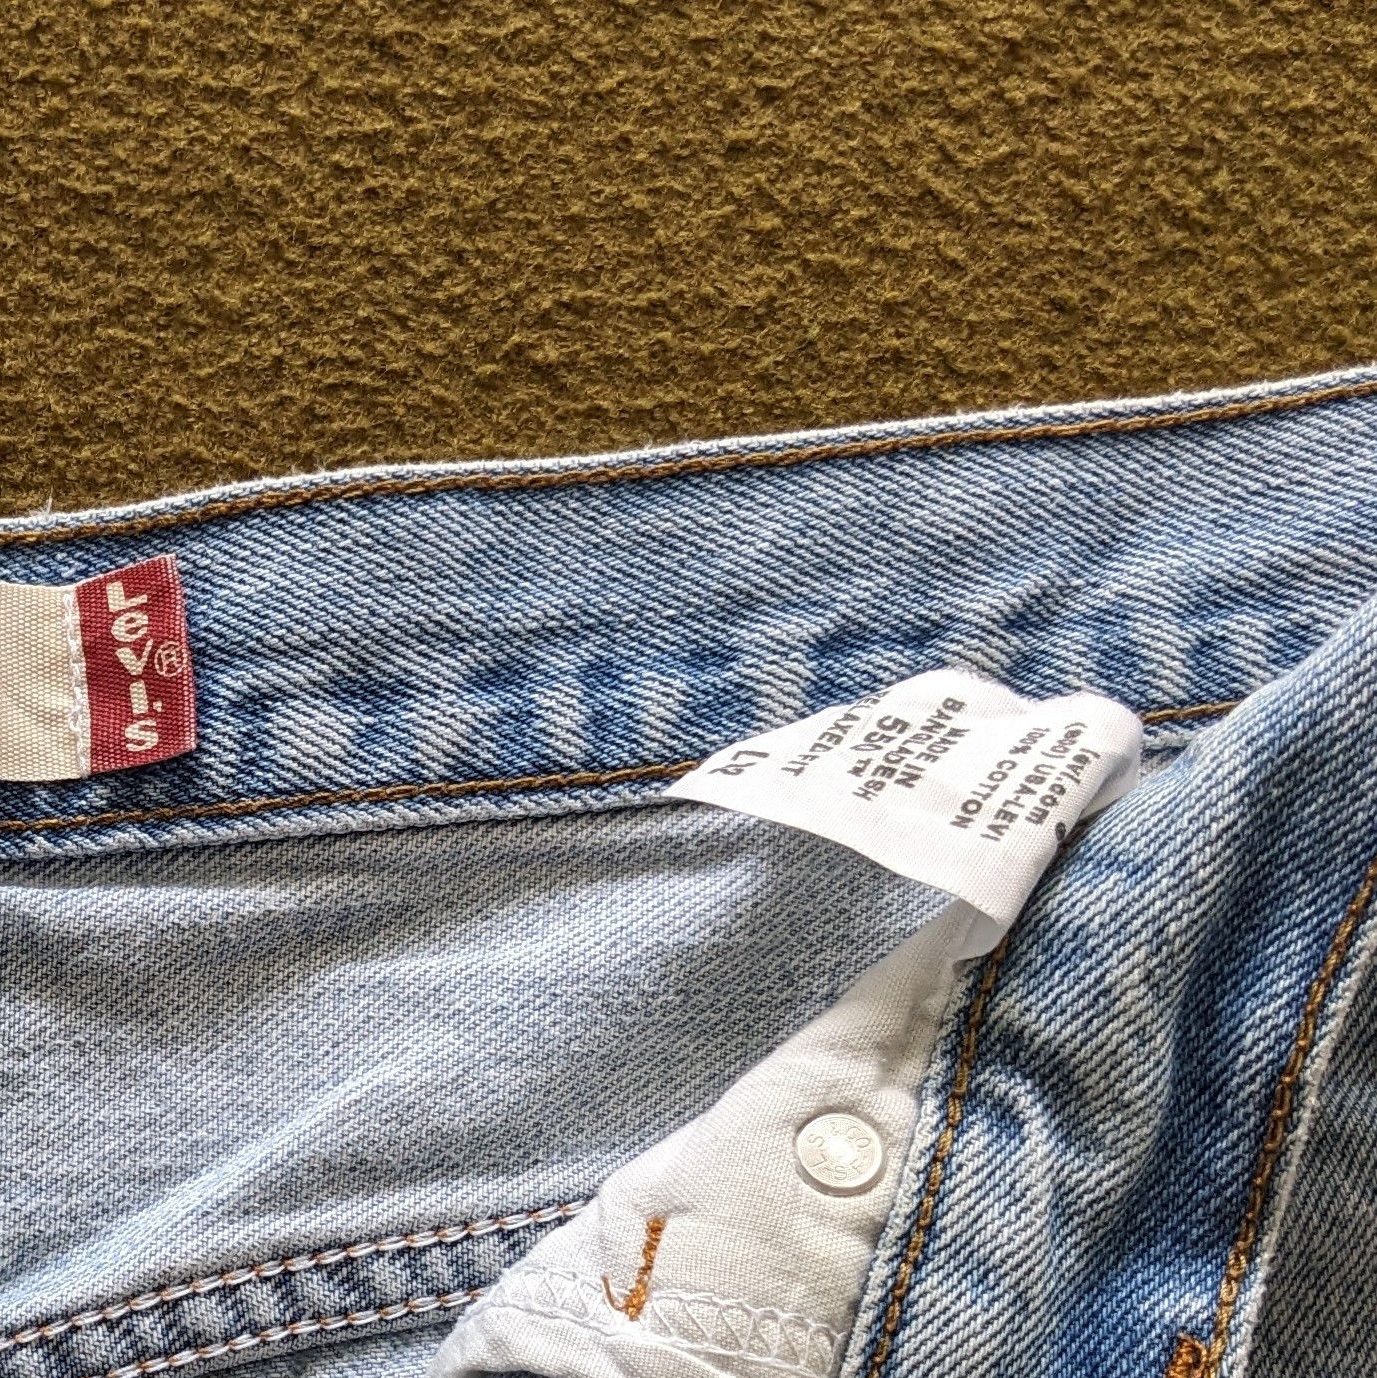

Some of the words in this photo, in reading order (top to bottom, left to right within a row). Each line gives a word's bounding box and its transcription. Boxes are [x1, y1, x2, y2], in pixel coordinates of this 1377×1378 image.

[849, 715, 911, 752] 550
[852, 697, 967, 802] BANGLADESH
[913, 727, 971, 763] MADE
[894, 763, 926, 789] IN
[950, 759, 1019, 829] COTTON
